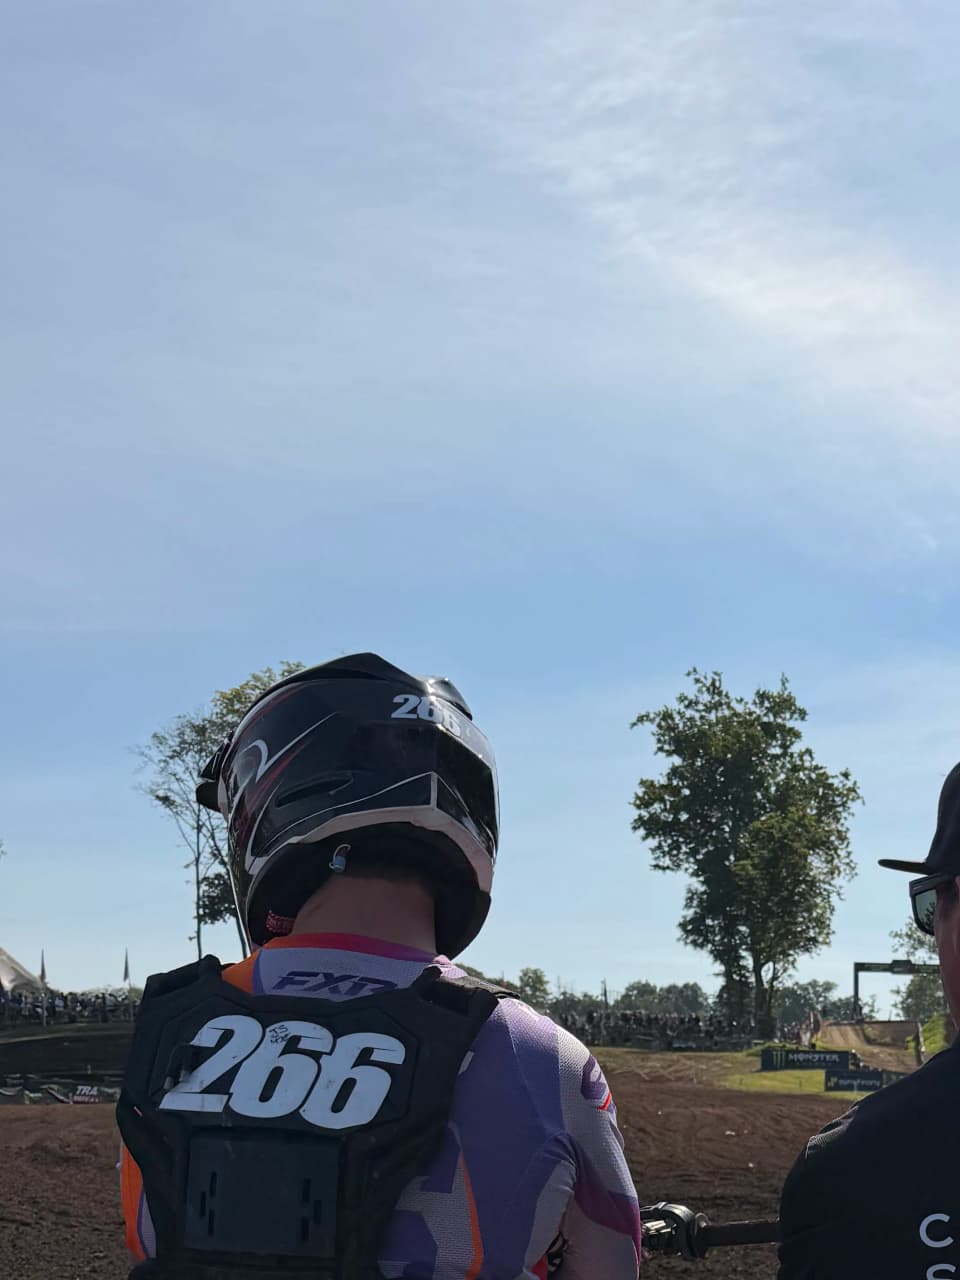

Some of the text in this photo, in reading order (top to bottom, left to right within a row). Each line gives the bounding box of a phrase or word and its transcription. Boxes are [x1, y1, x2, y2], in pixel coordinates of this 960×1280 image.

[391, 694, 460, 738] 266
[272, 971, 398, 996] FXR
[159, 1014, 406, 1129] 266
